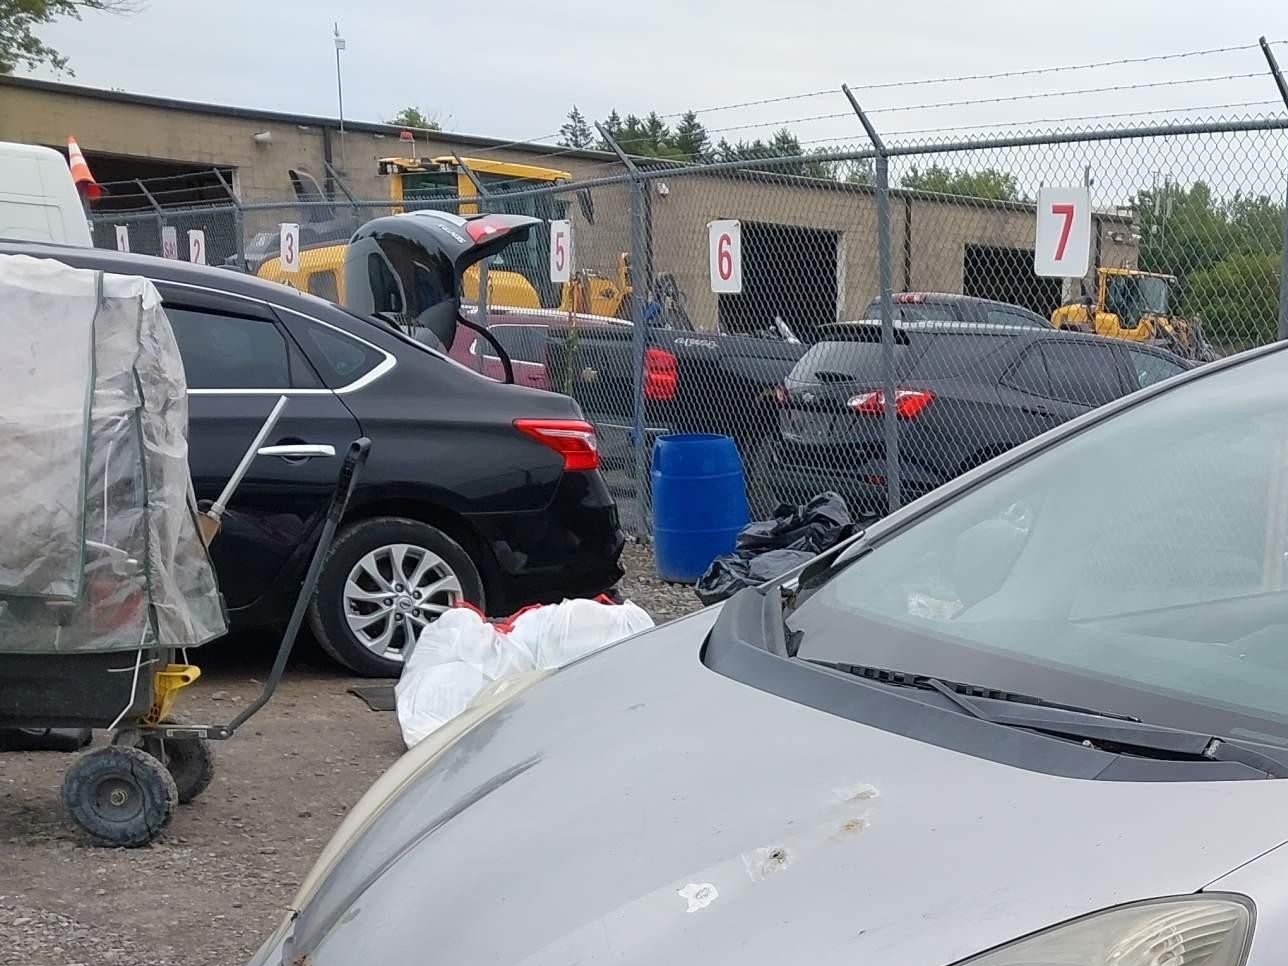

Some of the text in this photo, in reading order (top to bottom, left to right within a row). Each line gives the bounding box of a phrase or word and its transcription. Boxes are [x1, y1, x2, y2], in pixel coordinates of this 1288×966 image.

[193, 238, 201, 264] 2
[285, 232, 294, 264] 3
[555, 231, 565, 272] 5
[1051, 204, 1075, 261] 7
[718, 233, 732, 281] 6
